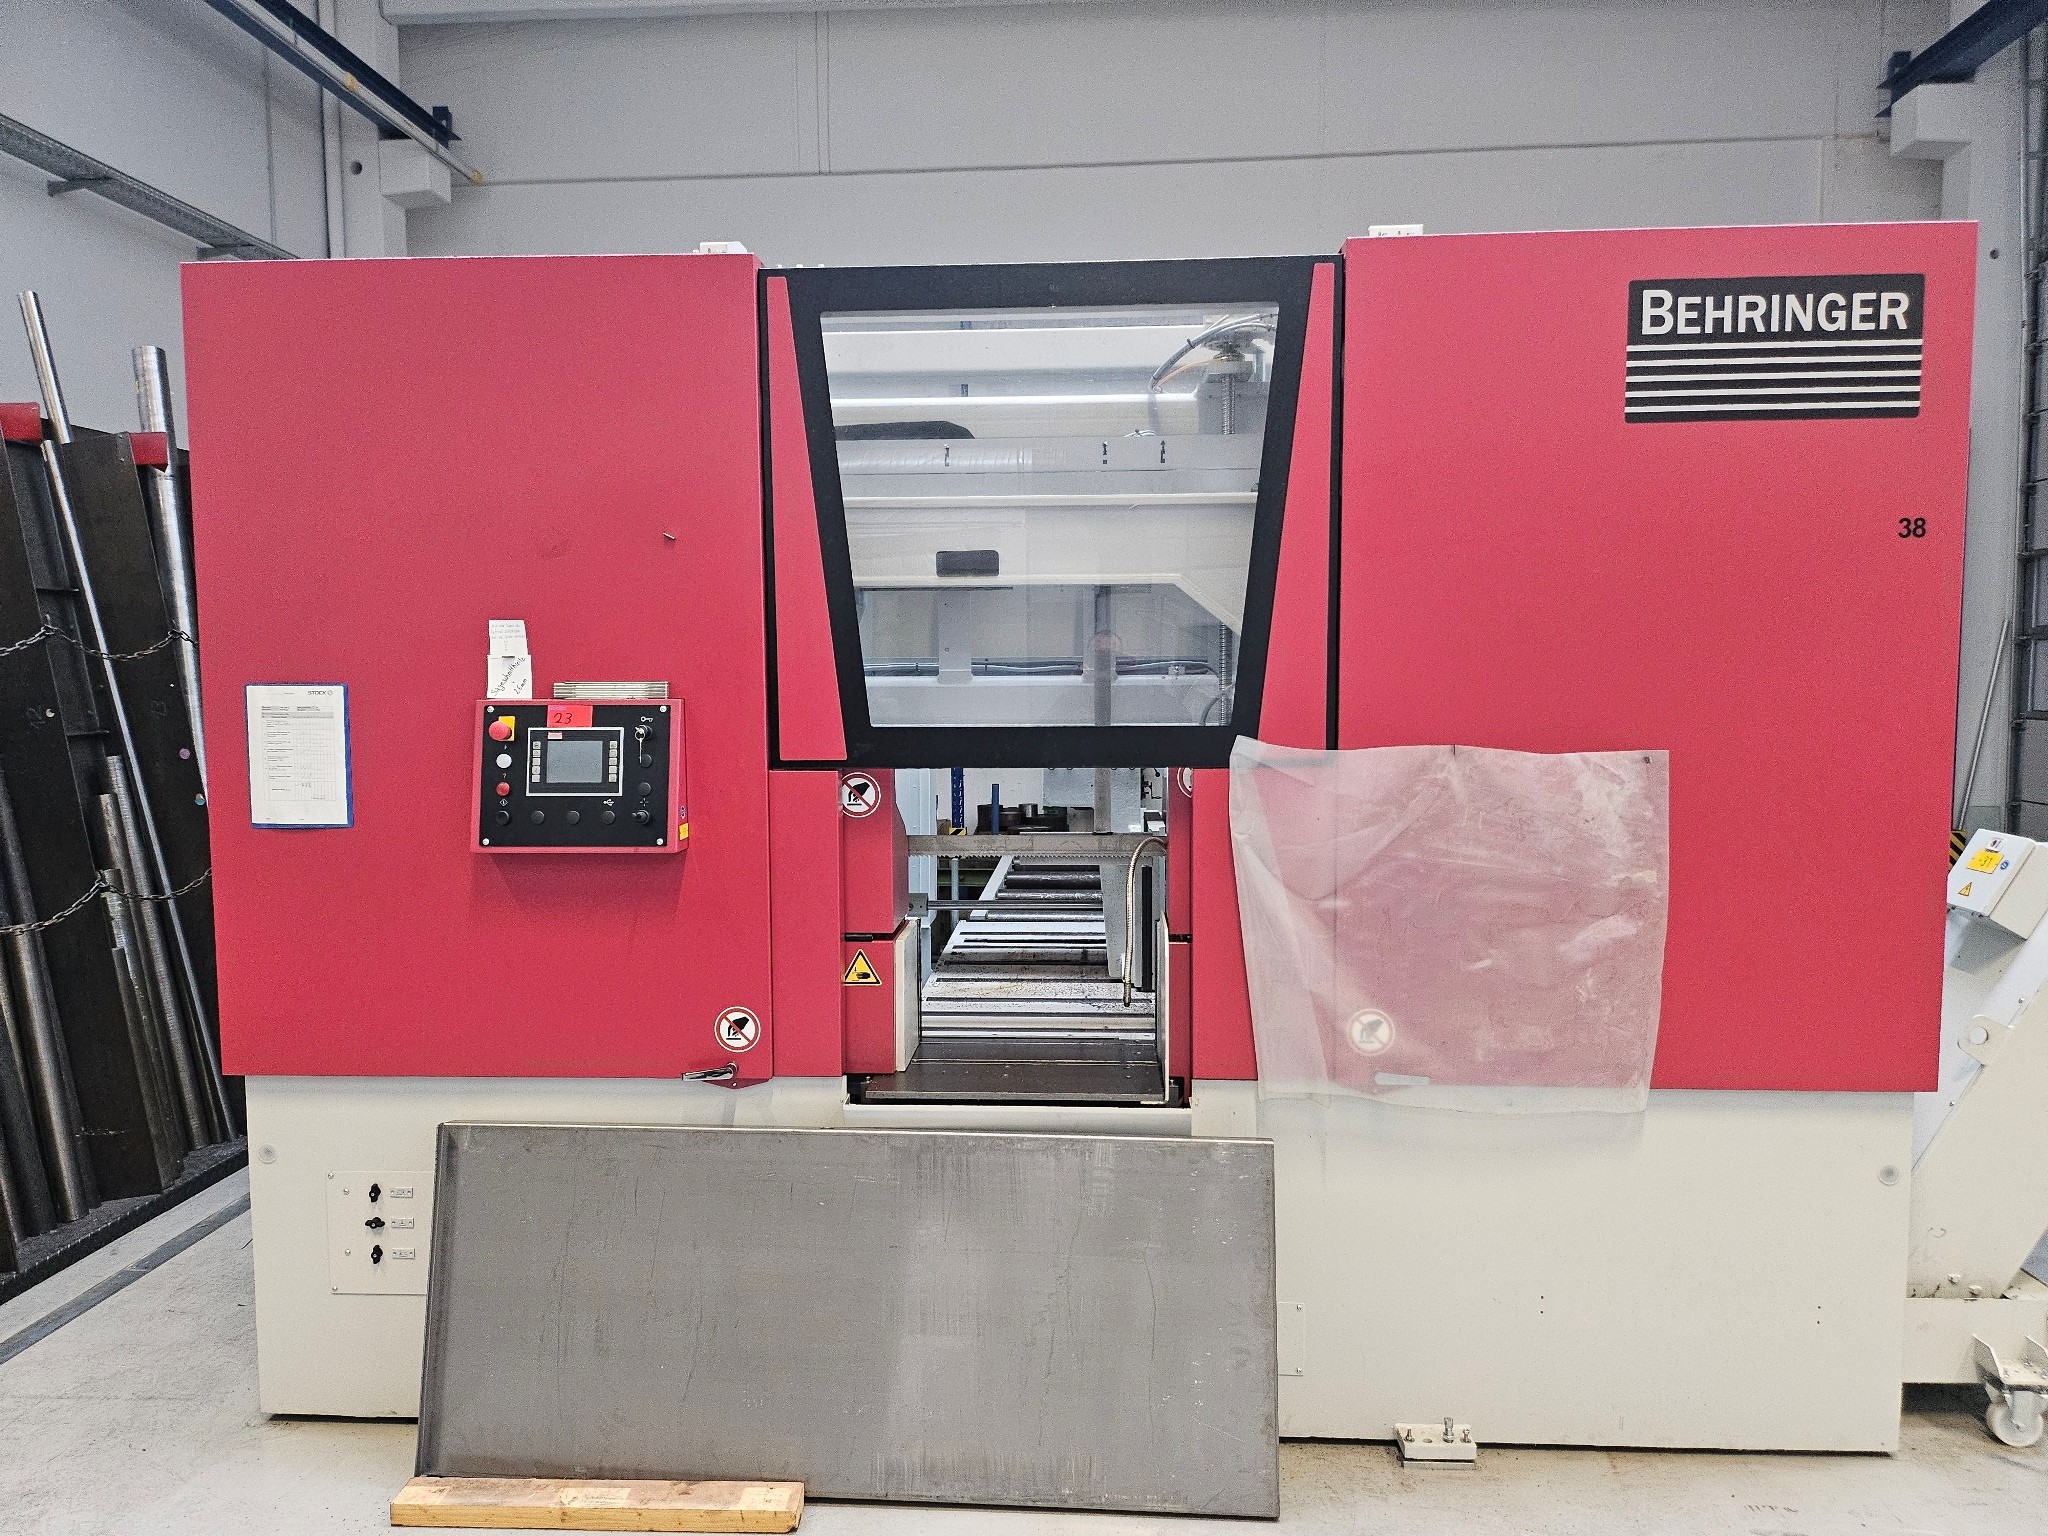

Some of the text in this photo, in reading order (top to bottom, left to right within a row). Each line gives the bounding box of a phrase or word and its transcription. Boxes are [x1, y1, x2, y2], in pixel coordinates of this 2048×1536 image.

[1641, 289, 1910, 335] BEHRINGER
[1897, 517, 1927, 539] 38
[553, 712, 573, 725] 23
